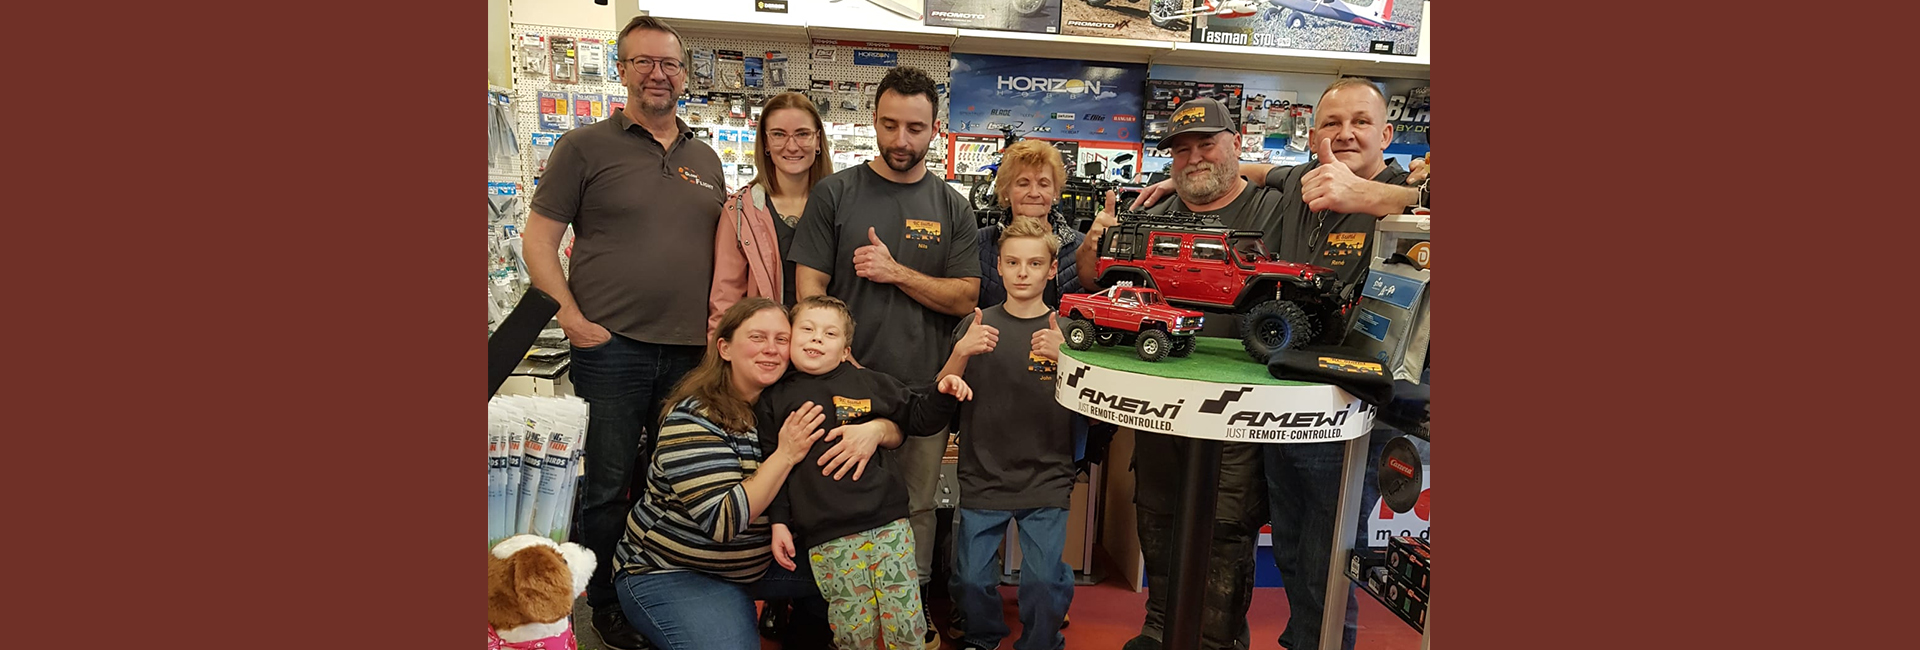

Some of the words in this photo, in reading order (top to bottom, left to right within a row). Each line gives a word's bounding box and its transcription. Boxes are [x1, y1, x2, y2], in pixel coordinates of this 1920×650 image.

[931, 11, 985, 19] PROMOTO
[1067, 20, 1115, 28] PROMOTO
[1201, 26, 1248, 45] Tasman
[1253, 33, 1276, 46] STOL
[997, 75, 1101, 95] HORIZON
[990, 108, 1012, 117] BLADE
[1396, 124, 1413, 132] BY
[1077, 401, 1090, 414] JUST
[1090, 405, 1174, 432] REMOTE-CONTROLLED.
[1225, 428, 1247, 439] JUST
[1249, 428, 1343, 440] REMOTE-CONTROLLED.
[1389, 459, 1413, 475] Carrera
